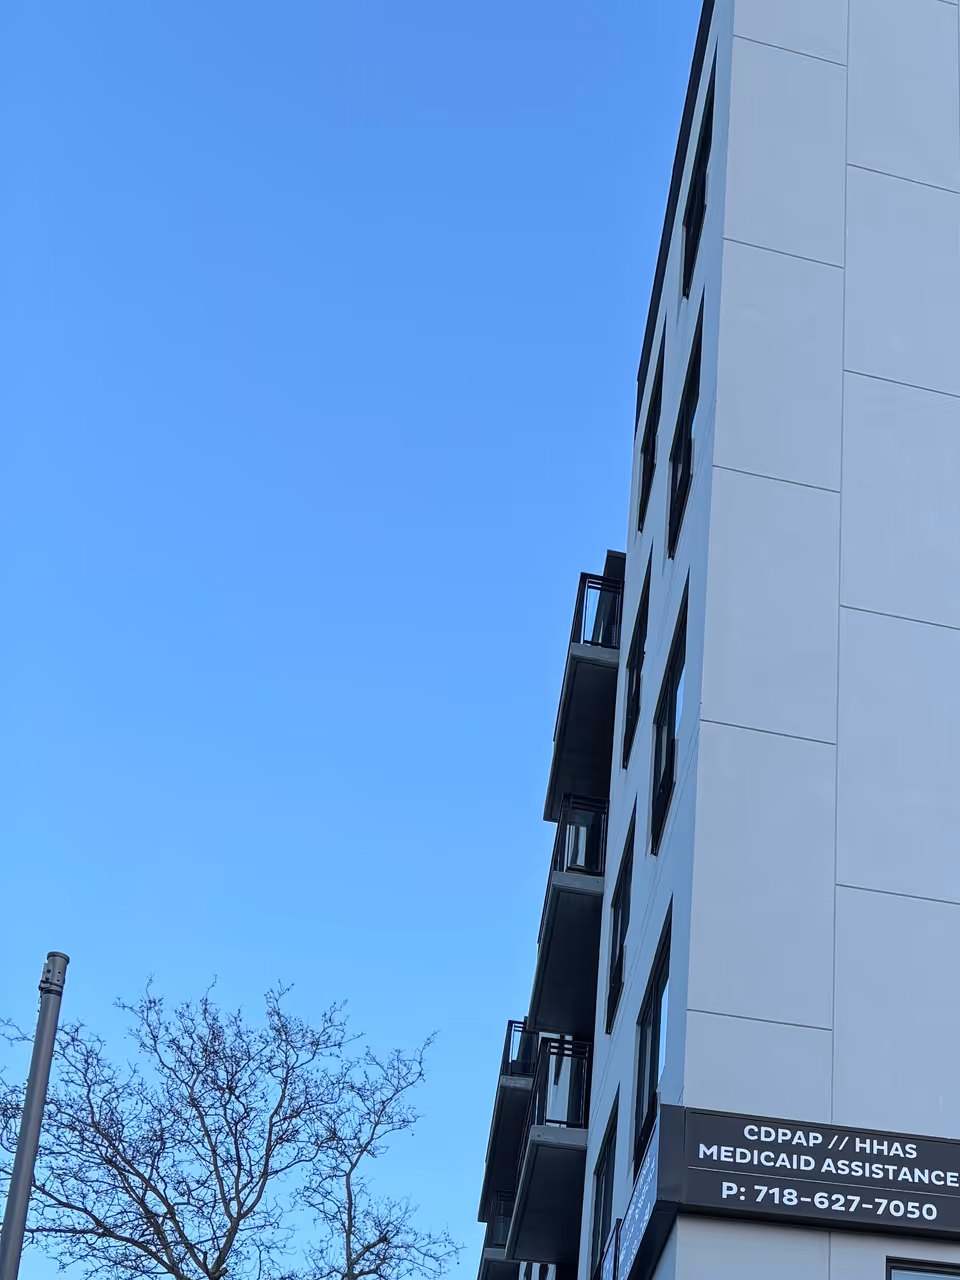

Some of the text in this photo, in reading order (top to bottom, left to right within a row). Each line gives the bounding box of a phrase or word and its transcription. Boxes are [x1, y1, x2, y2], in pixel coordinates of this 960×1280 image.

[743, 1124, 917, 1159] CDPAP // HHAS
[698, 1143, 960, 1187] MEDICAID ASSISTANCE
[721, 1181, 937, 1221] P: 718-627-7050
